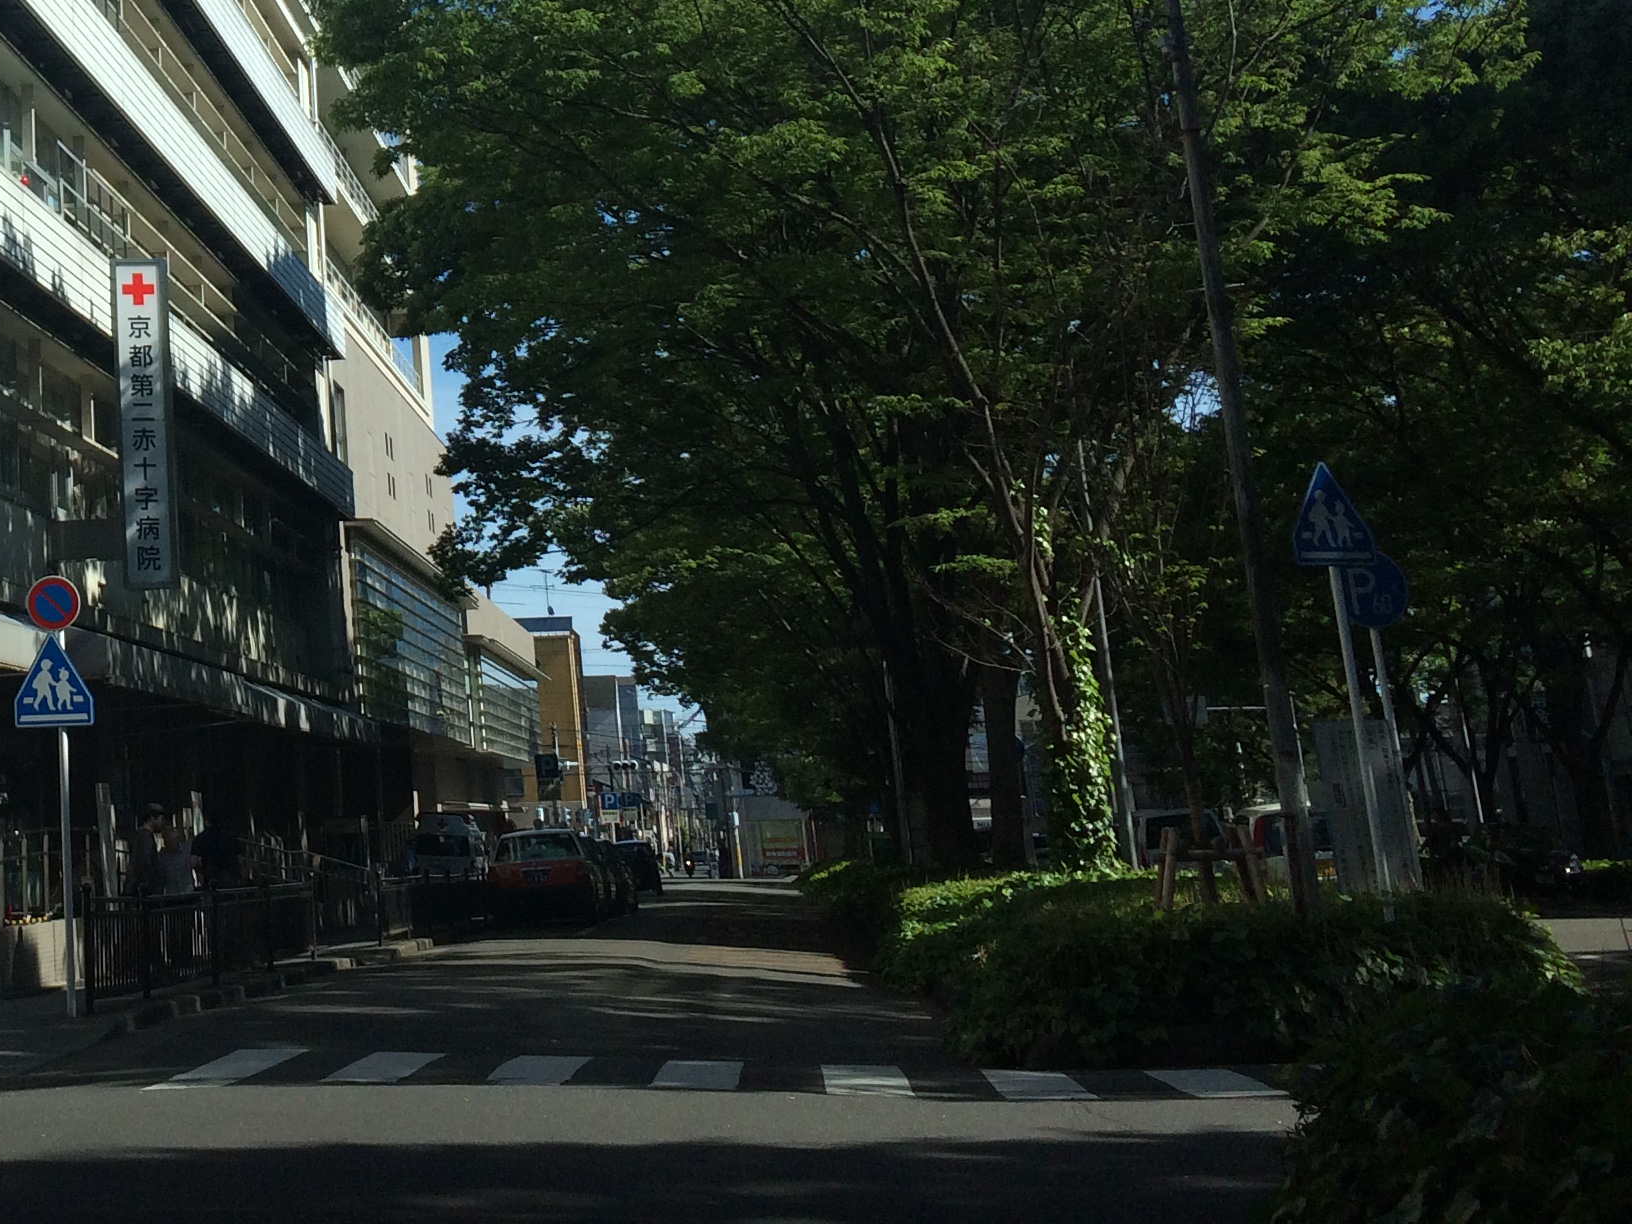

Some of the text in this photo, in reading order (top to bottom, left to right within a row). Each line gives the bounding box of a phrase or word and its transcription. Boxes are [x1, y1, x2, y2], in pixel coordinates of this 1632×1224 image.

[127, 315, 162, 572] 京都第二赤十字病院
[1347, 568, 1376, 615] P
[604, 793, 615, 809] P
